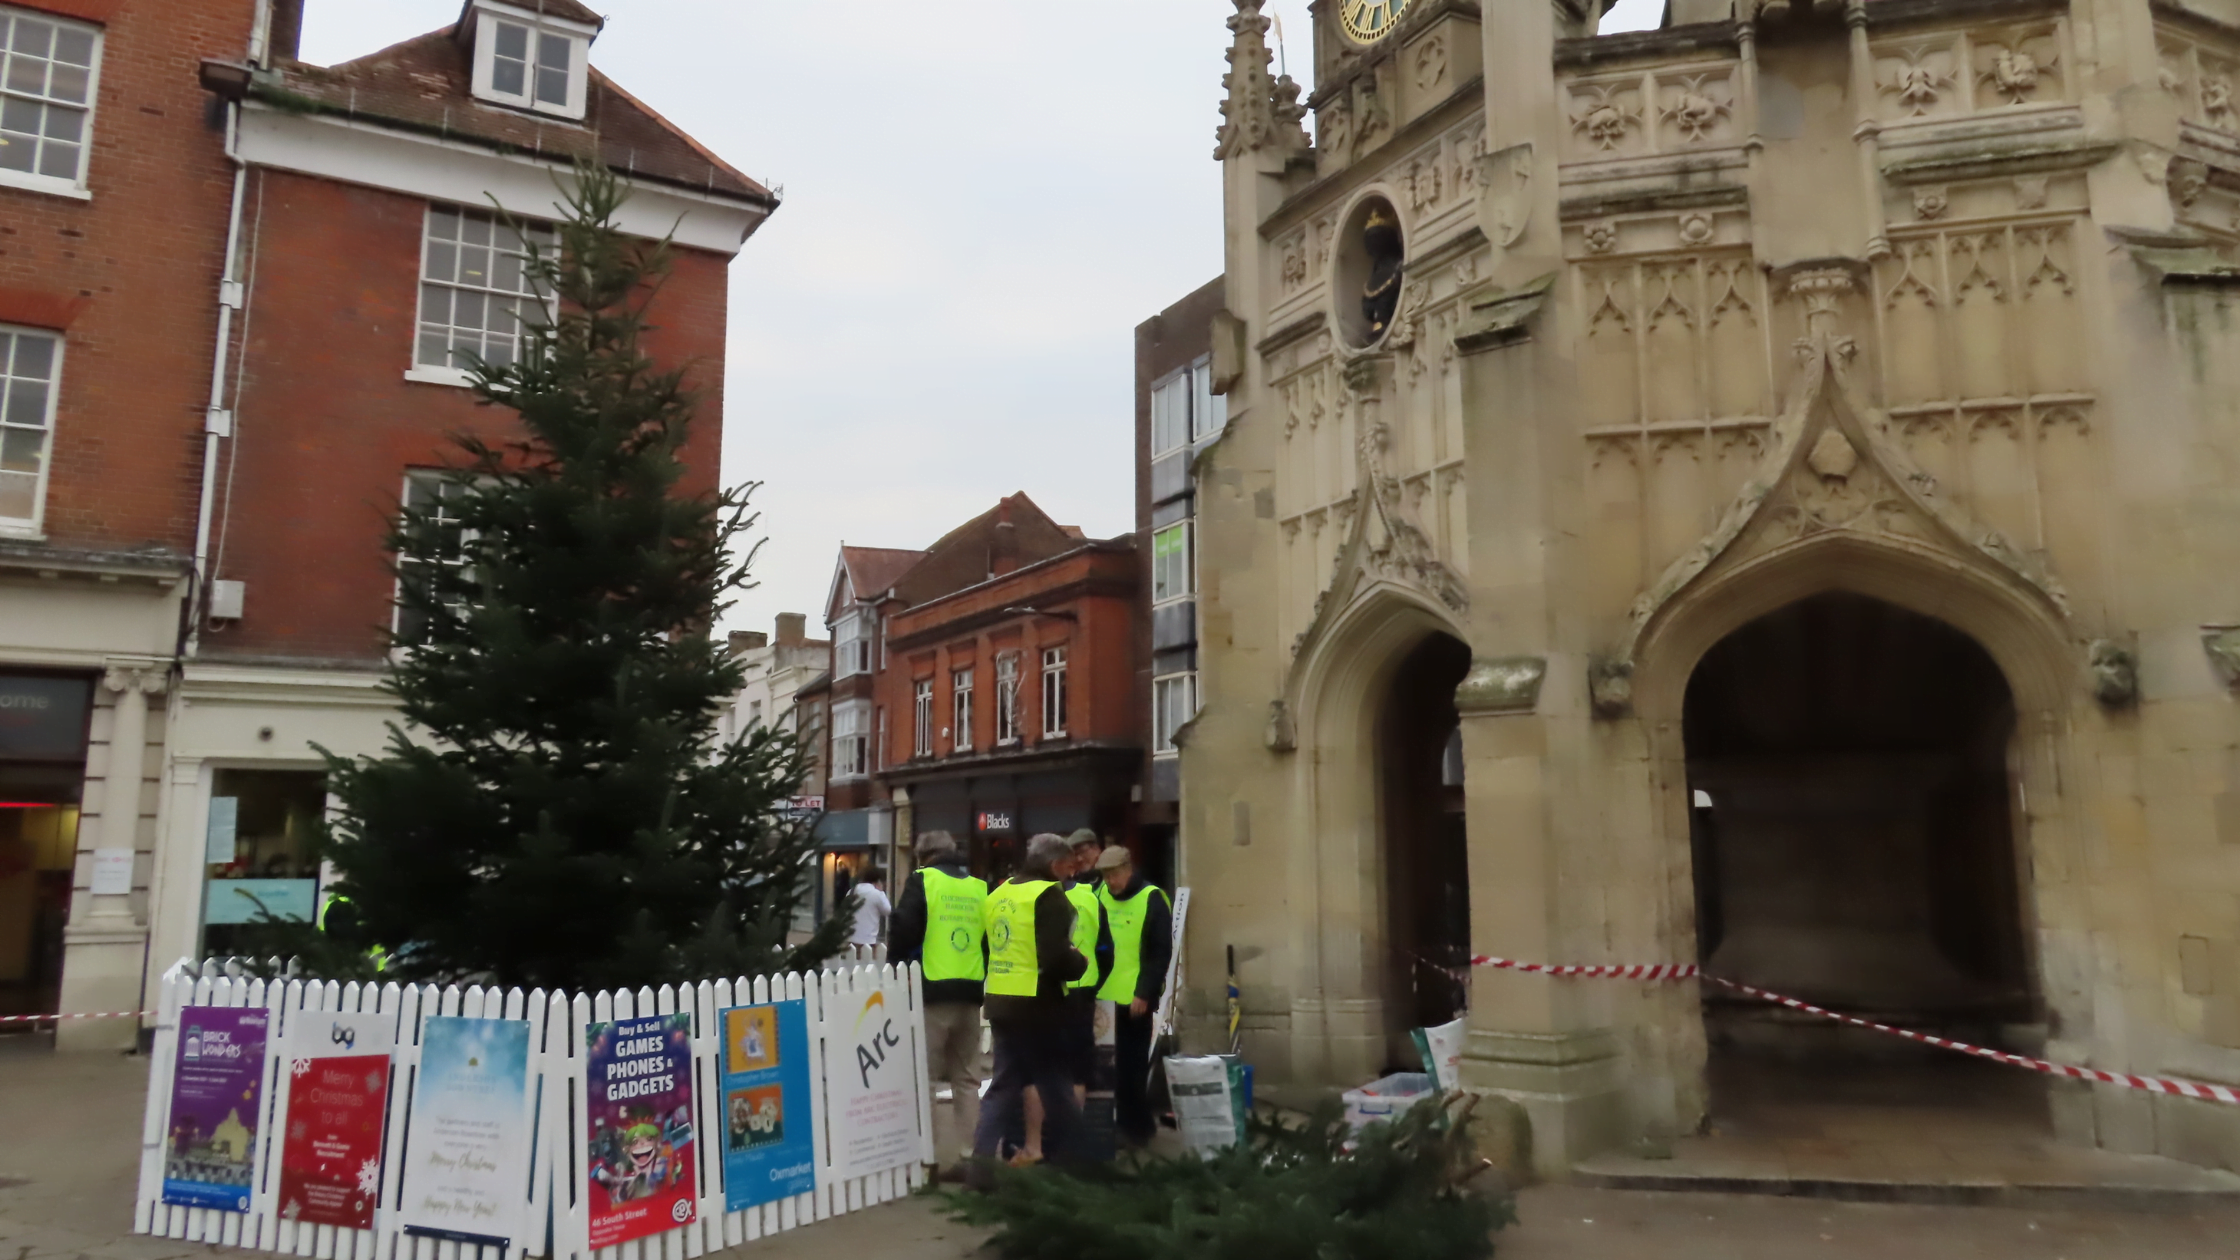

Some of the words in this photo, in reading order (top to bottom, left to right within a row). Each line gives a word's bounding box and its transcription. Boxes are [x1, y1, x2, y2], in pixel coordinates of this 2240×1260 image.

[986, 813, 1010, 829] Blacks
[203, 1031, 231, 1043] BRICK
[619, 1026, 635, 1036] Buy
[636, 1023, 643, 1033] &
[645, 1021, 660, 1032] Sell
[202, 1042, 242, 1058] WONDERS
[615, 1036, 664, 1057] GAMES
[856, 1018, 900, 1089] Arc
[607, 1056, 664, 1080] PHONES
[667, 1058, 673, 1067] &
[322, 1068, 355, 1089] Merry
[607, 1074, 674, 1101] GADGETS
[310, 1087, 364, 1107] Christmas
[321, 1111, 333, 1124] to
[334, 1111, 348, 1125] all
[769, 1161, 812, 1181] Oxmarket
[592, 1218, 601, 1227] 46
[602, 1212, 624, 1225] South
[624, 1208, 648, 1220] Street
